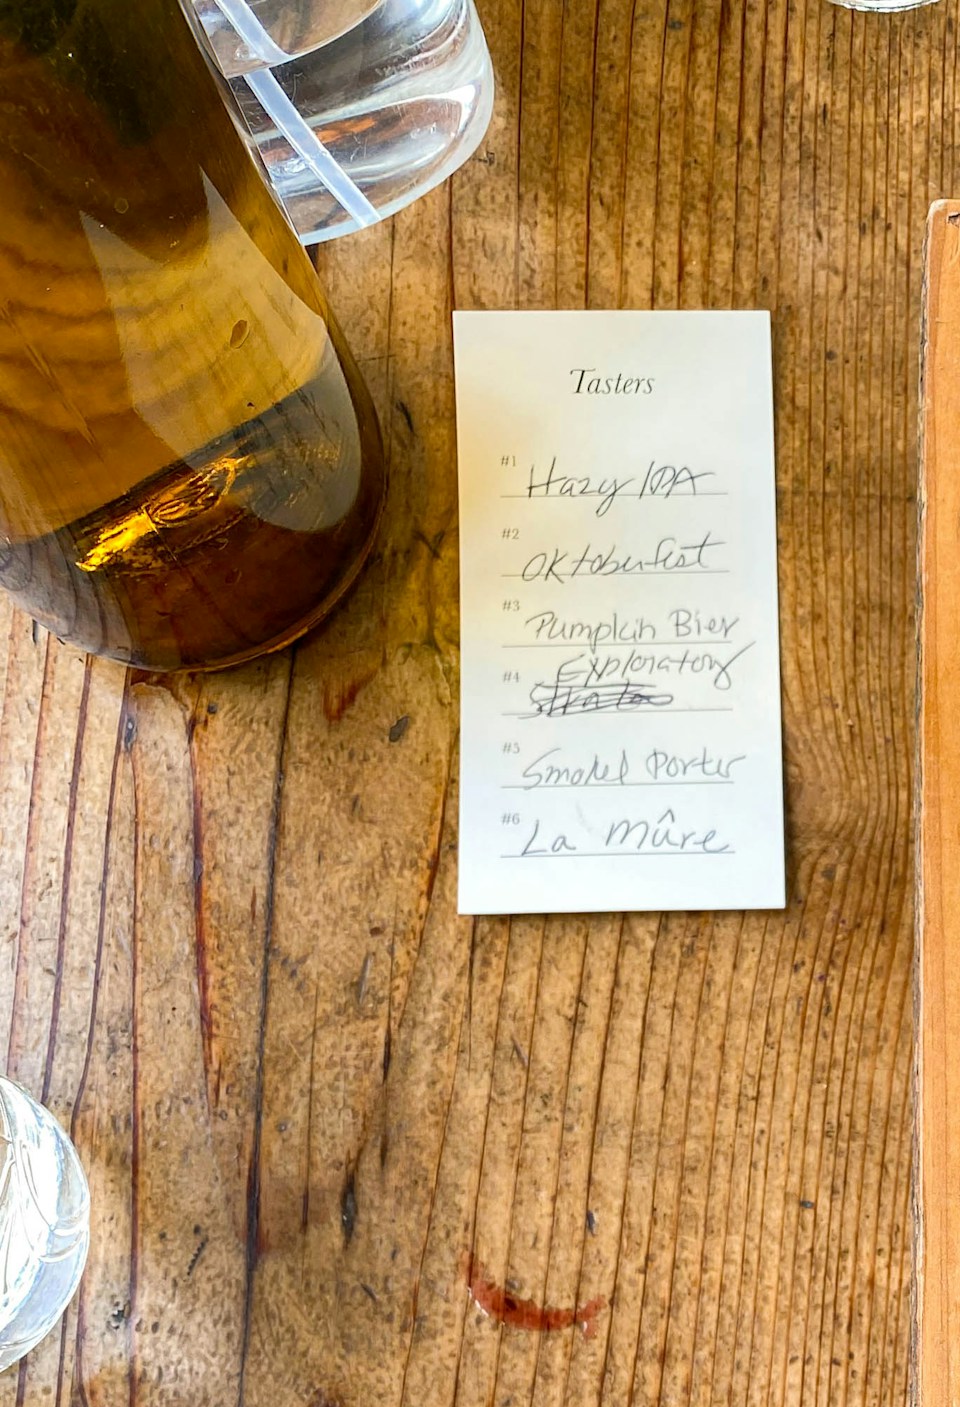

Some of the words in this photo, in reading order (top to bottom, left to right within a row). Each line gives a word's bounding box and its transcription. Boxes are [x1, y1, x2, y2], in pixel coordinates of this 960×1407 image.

[570, 368, 655, 394] Tasters
[500, 456, 517, 467] #1
[527, 457, 636, 517] Hazy
[639, 461, 716, 499] IPA
[501, 528, 520, 540] #2
[502, 600, 520, 612] #3
[525, 611, 656, 654] Pumpkin
[669, 609, 740, 638] Bier
[502, 671, 520, 683] #4
[502, 742, 520, 754] #5
[501, 813, 520, 825] #6
[521, 820, 576, 856] La
